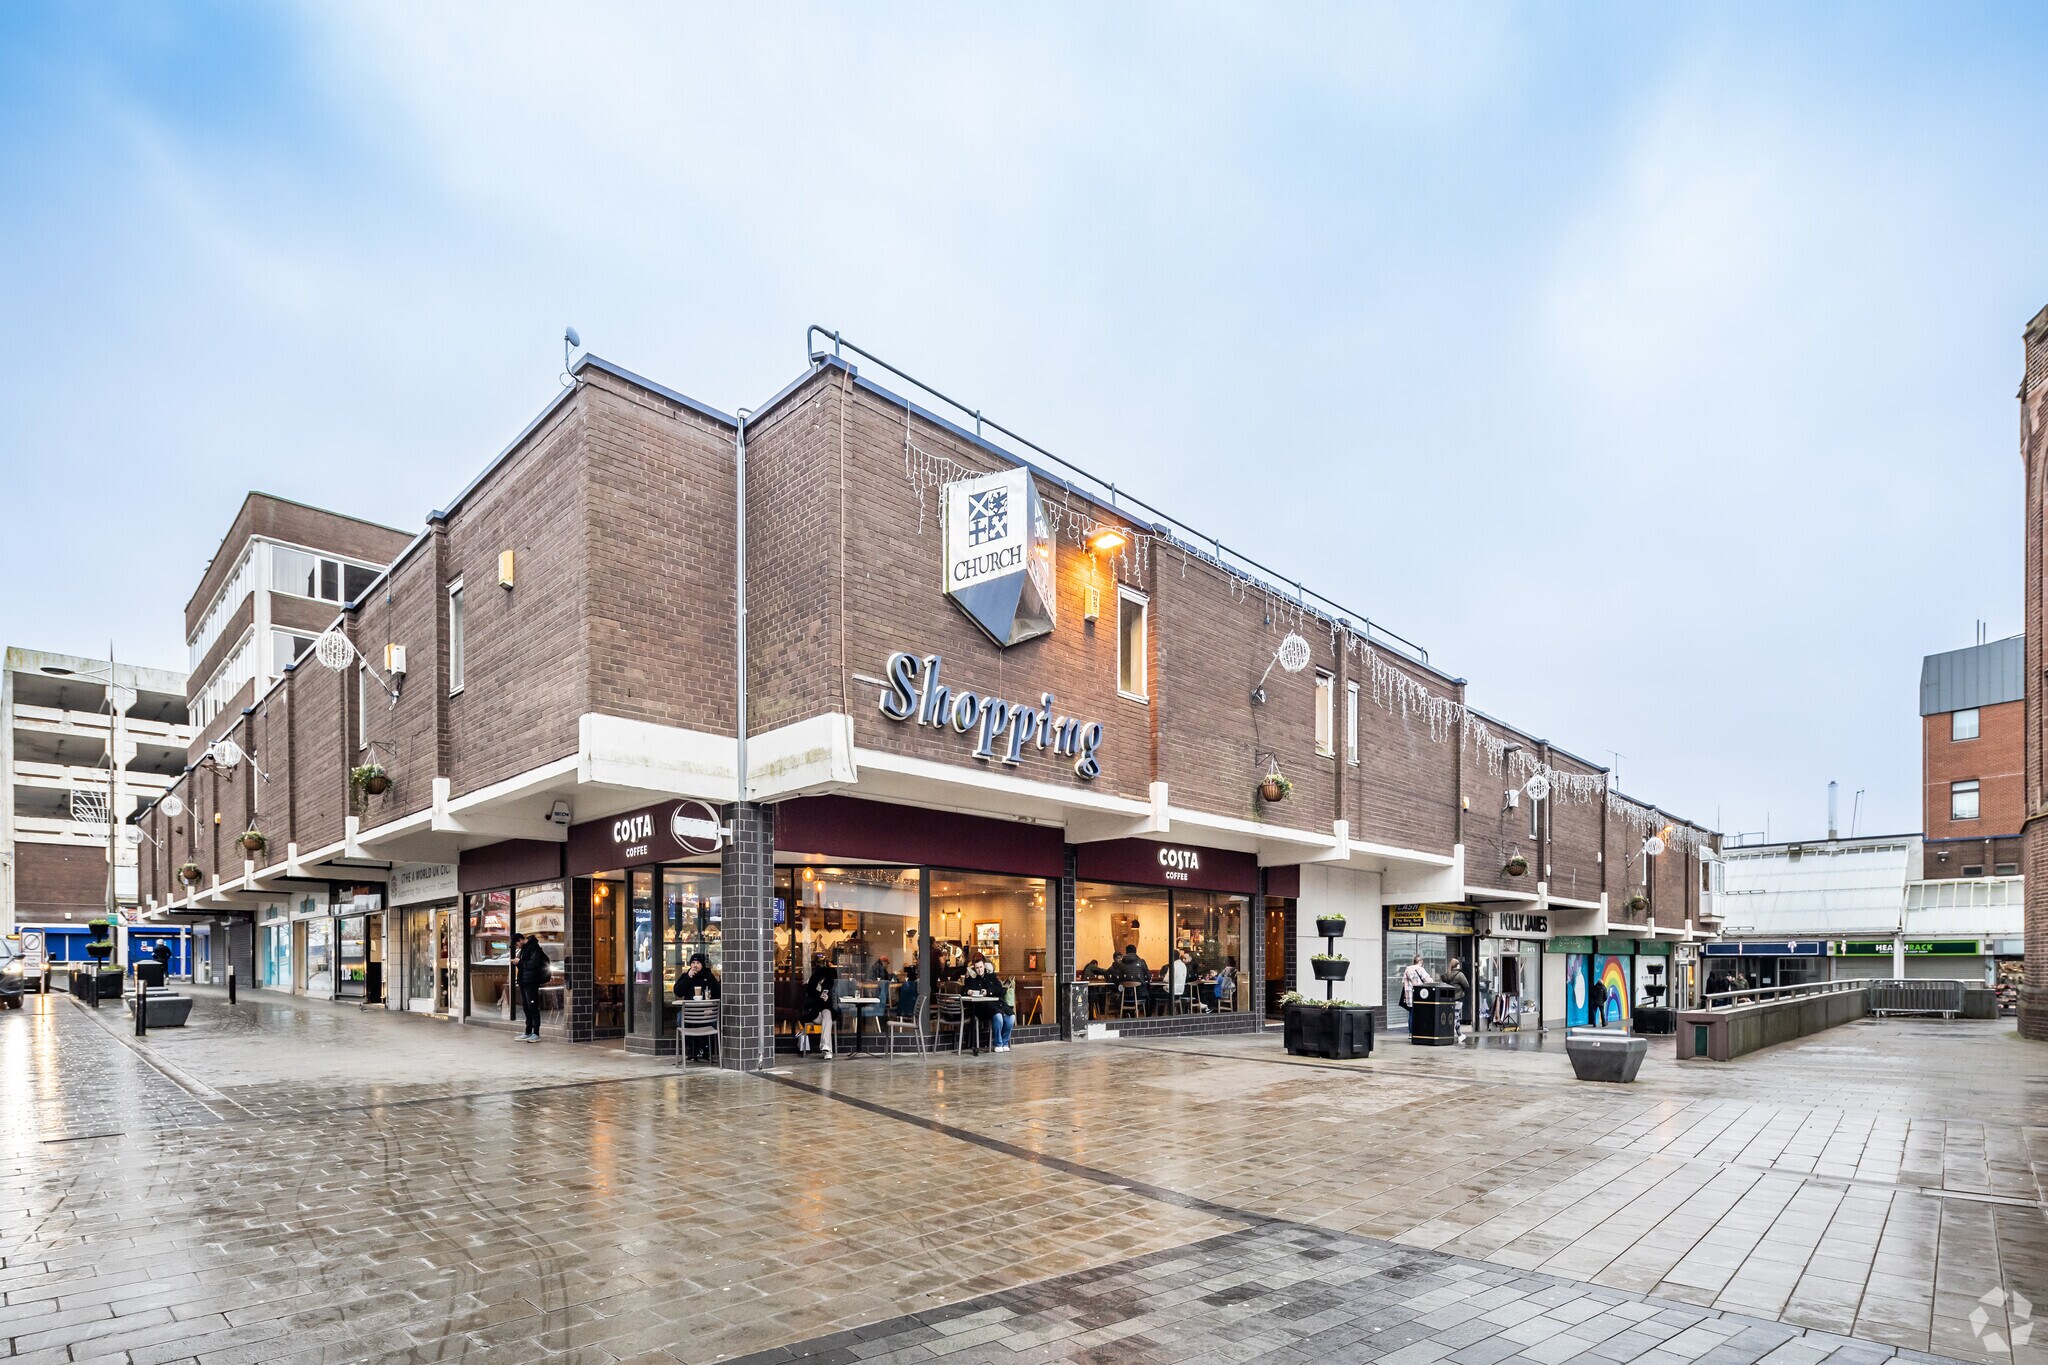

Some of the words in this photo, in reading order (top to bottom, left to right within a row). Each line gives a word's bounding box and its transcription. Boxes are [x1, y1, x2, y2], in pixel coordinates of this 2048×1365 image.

[953, 543, 1023, 582] CHURCH
[878, 651, 1104, 780] Shopping
[613, 814, 655, 843] COSTA
[625, 845, 648, 858] COFFEE
[1158, 848, 1199, 870] COSTA
[1165, 871, 1188, 881] COFFEE
